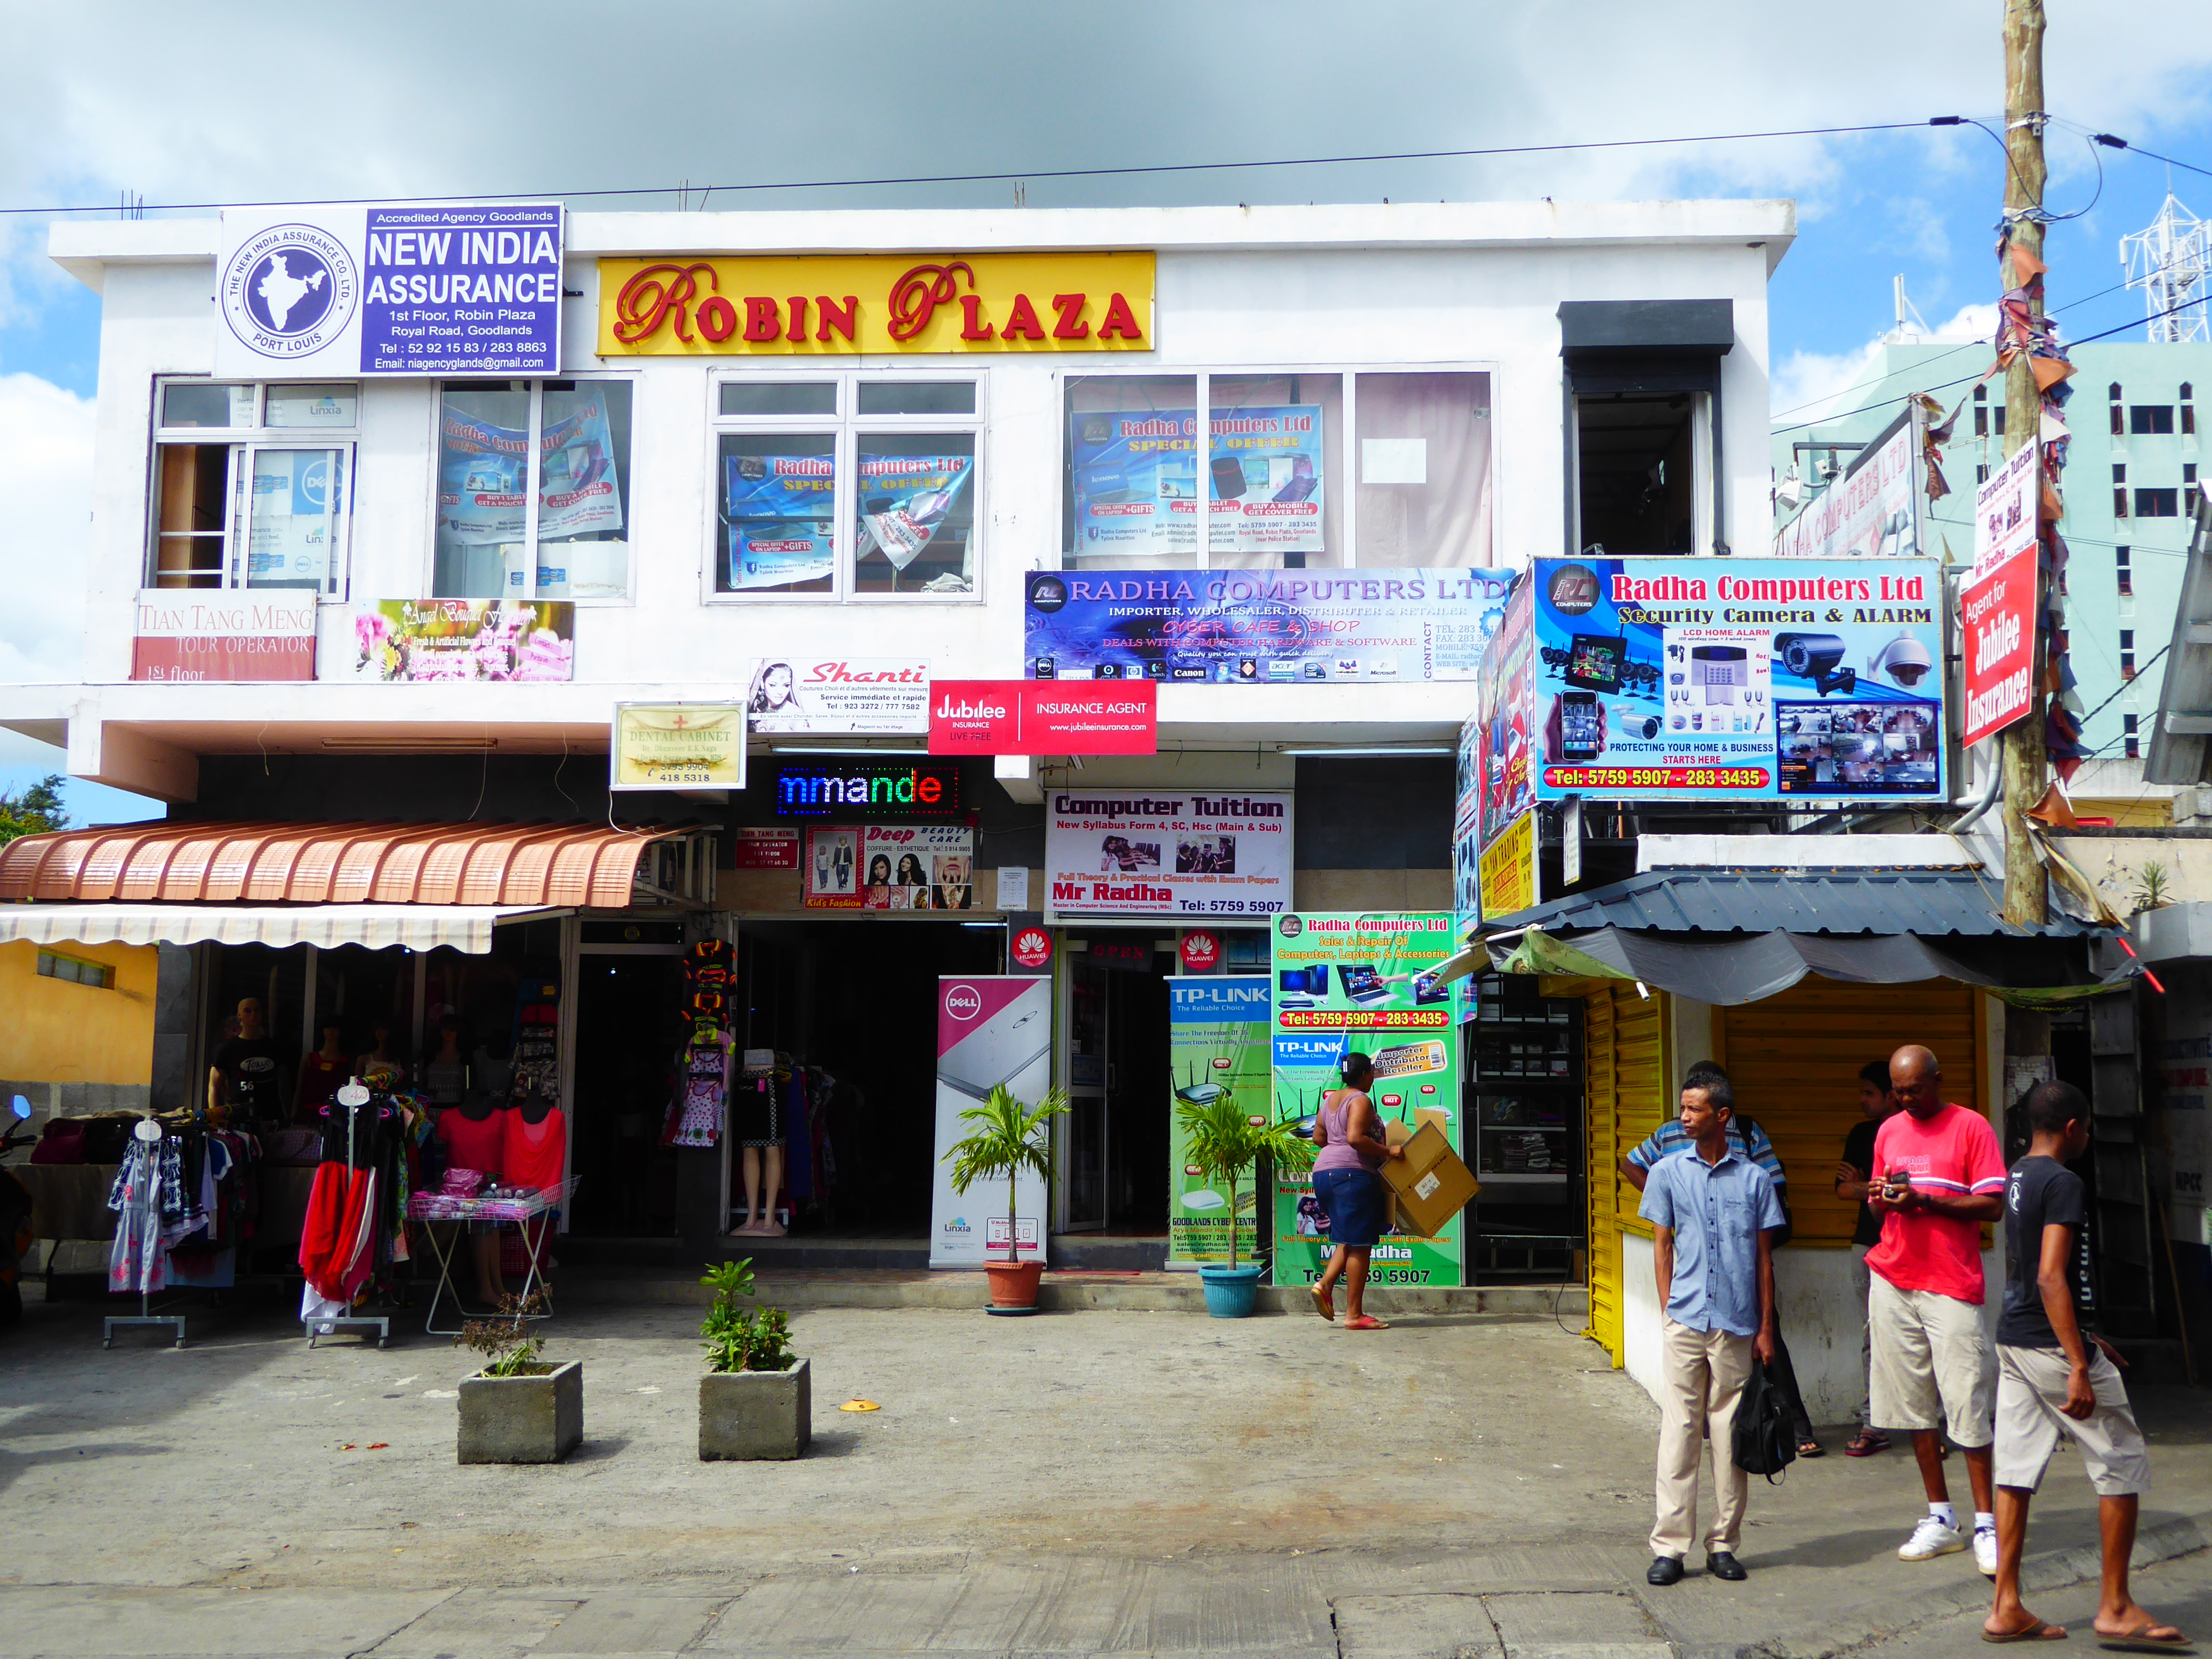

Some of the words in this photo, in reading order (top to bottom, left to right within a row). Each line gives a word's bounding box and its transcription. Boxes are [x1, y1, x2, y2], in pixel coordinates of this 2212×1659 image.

[377, 213, 439, 222] Accredited
[441, 213, 487, 224] Agency
[490, 212, 553, 221] Goodlands
[369, 233, 451, 265] NEW
[461, 231, 557, 264] INDIA
[229, 278, 238, 296] THE
[236, 253, 253, 273] NEW
[252, 235, 279, 254] INDIA
[283, 232, 338, 260] ASSURANCE
[366, 274, 555, 304] ASSURANCE
[613, 264, 858, 342] ROBIN
[888, 262, 1141, 340] PLAZA
[389, 311, 408, 321] 1st
[413, 310, 449, 322] Floor,
[455, 310, 493, 320] Robin
[499, 310, 535, 320] Plaza
[392, 327, 424, 337] Royal
[429, 326, 463, 337] Road,
[468, 325, 532, 336] Goodlands
[253, 333, 284, 351] PORT
[288, 333, 322, 351] LOUIS
[380, 343, 397, 353] Tel
[408, 343, 424, 353] 52
[427, 343, 442, 353] 92
[446, 343, 461, 353] 15
[465, 343, 479, 353] 83
[490, 343, 513, 353] 283
[517, 342, 546, 352] 8863
[375, 358, 405, 369] Email:
[408, 357, 543, 370] niagencyglands@gmail.com
[310, 405, 341, 415] Linxia
[1120, 420, 1178, 436] Radha
[1283, 416, 1311, 432] Ltd
[1227, 437, 1299, 448] OFFER
[1092, 473, 1119, 483] lenovo
[1978, 469, 2008, 507] Computer
[2010, 446, 2033, 477] Tuition
[1071, 581, 1199, 602] RADHA
[1207, 579, 1426, 602] COMPUTERS
[1439, 579, 1505, 598] LTD
[1612, 575, 1708, 603] Radha
[1717, 575, 1870, 606] Computers
[1879, 575, 1923, 601] Ltd
[1966, 594, 1992, 624] Agent
[1993, 580, 2006, 605] for
[140, 606, 184, 630] TIAN
[191, 606, 244, 630] TANG
[252, 606, 311, 630] MENG
[1109, 606, 1183, 617] IMPORTER,
[1188, 606, 1285, 617] WHOLESALER,
[1619, 606, 1714, 625] Security
[1724, 608, 1814, 623] Camera
[1853, 608, 1932, 623] ALARM
[1162, 620, 1224, 634] CYBER
[1233, 620, 1281, 633] CAFE
[1308, 620, 1360, 633] SHOP
[176, 637, 218, 653] TOUR
[226, 635, 309, 653] OPERATOR
[1975, 610, 2020, 676] Jubilee
[170, 666, 204, 681] floor
[803, 662, 926, 682] Shanti
[937, 693, 1006, 718] Jubilee
[1036, 703, 1104, 713] INSURANCE
[1108, 702, 1146, 713] AGENT
[1967, 666, 2027, 735] Insurance
[1049, 723, 1146, 732] www.jubileeinsurance.com
[630, 732, 676, 741] DENTAL
[680, 732, 731, 741] CABINET
[1610, 743, 1665, 753] PROTECTING
[1668, 743, 1691, 753] YOUR
[1693, 743, 1719, 753] HOME
[1731, 743, 1773, 753] BUSINESS
[1663, 755, 1694, 764] STARTS
[1698, 755, 1721, 764] HERE
[1553, 770, 1583, 786] Tel:
[1588, 770, 1626, 786] 5759
[1631, 770, 1671, 786] 5907
[1686, 770, 1717, 786] 283
[1720, 770, 1760, 786] 3435
[1055, 795, 1183, 819] Computer
[1191, 797, 1284, 817] Tuition
[1083, 821, 1125, 831] Syllabus
[867, 827, 915, 843] Deep
[1498, 829, 1519, 867] TRADING
[1052, 883, 1086, 900] Mr
[1093, 883, 1172, 901] Radha
[807, 899, 826, 907] Kid's
[829, 899, 861, 907] Fashion
[1180, 900, 1204, 911] Tel:
[1210, 901, 1244, 911] 5759
[1249, 901, 1284, 912] 5907
[1308, 919, 1350, 931] Radha
[1355, 918, 1424, 932] Computers
[1427, 919, 1448, 931] Ltd
[1319, 936, 1344, 946] Sales
[1358, 936, 1391, 947] Repair
[1395, 936, 1408, 946] Of
[1094, 944, 1145, 959] OPEN
[1277, 949, 1335, 959] Computers,
[1339, 949, 1380, 959] Laptops
[1395, 949, 1449, 959] Accessories
[1171, 988, 1270, 1003] TP-LINK
[950, 998, 977, 1008] DELL
[1287, 1014, 1310, 1025] Tel:
[1313, 1014, 1343, 1025] 5759
[1346, 1014, 1375, 1025] 5907
[1386, 1014, 1410, 1025] 283
[1412, 1014, 1442, 1025] 3435
[1276, 1042, 1343, 1052] TP-LINK
[1375, 1054, 1428, 1067] Distributor
[1384, 1064, 1423, 1074] Reseller
[944, 1224, 971, 1233] Linxia
